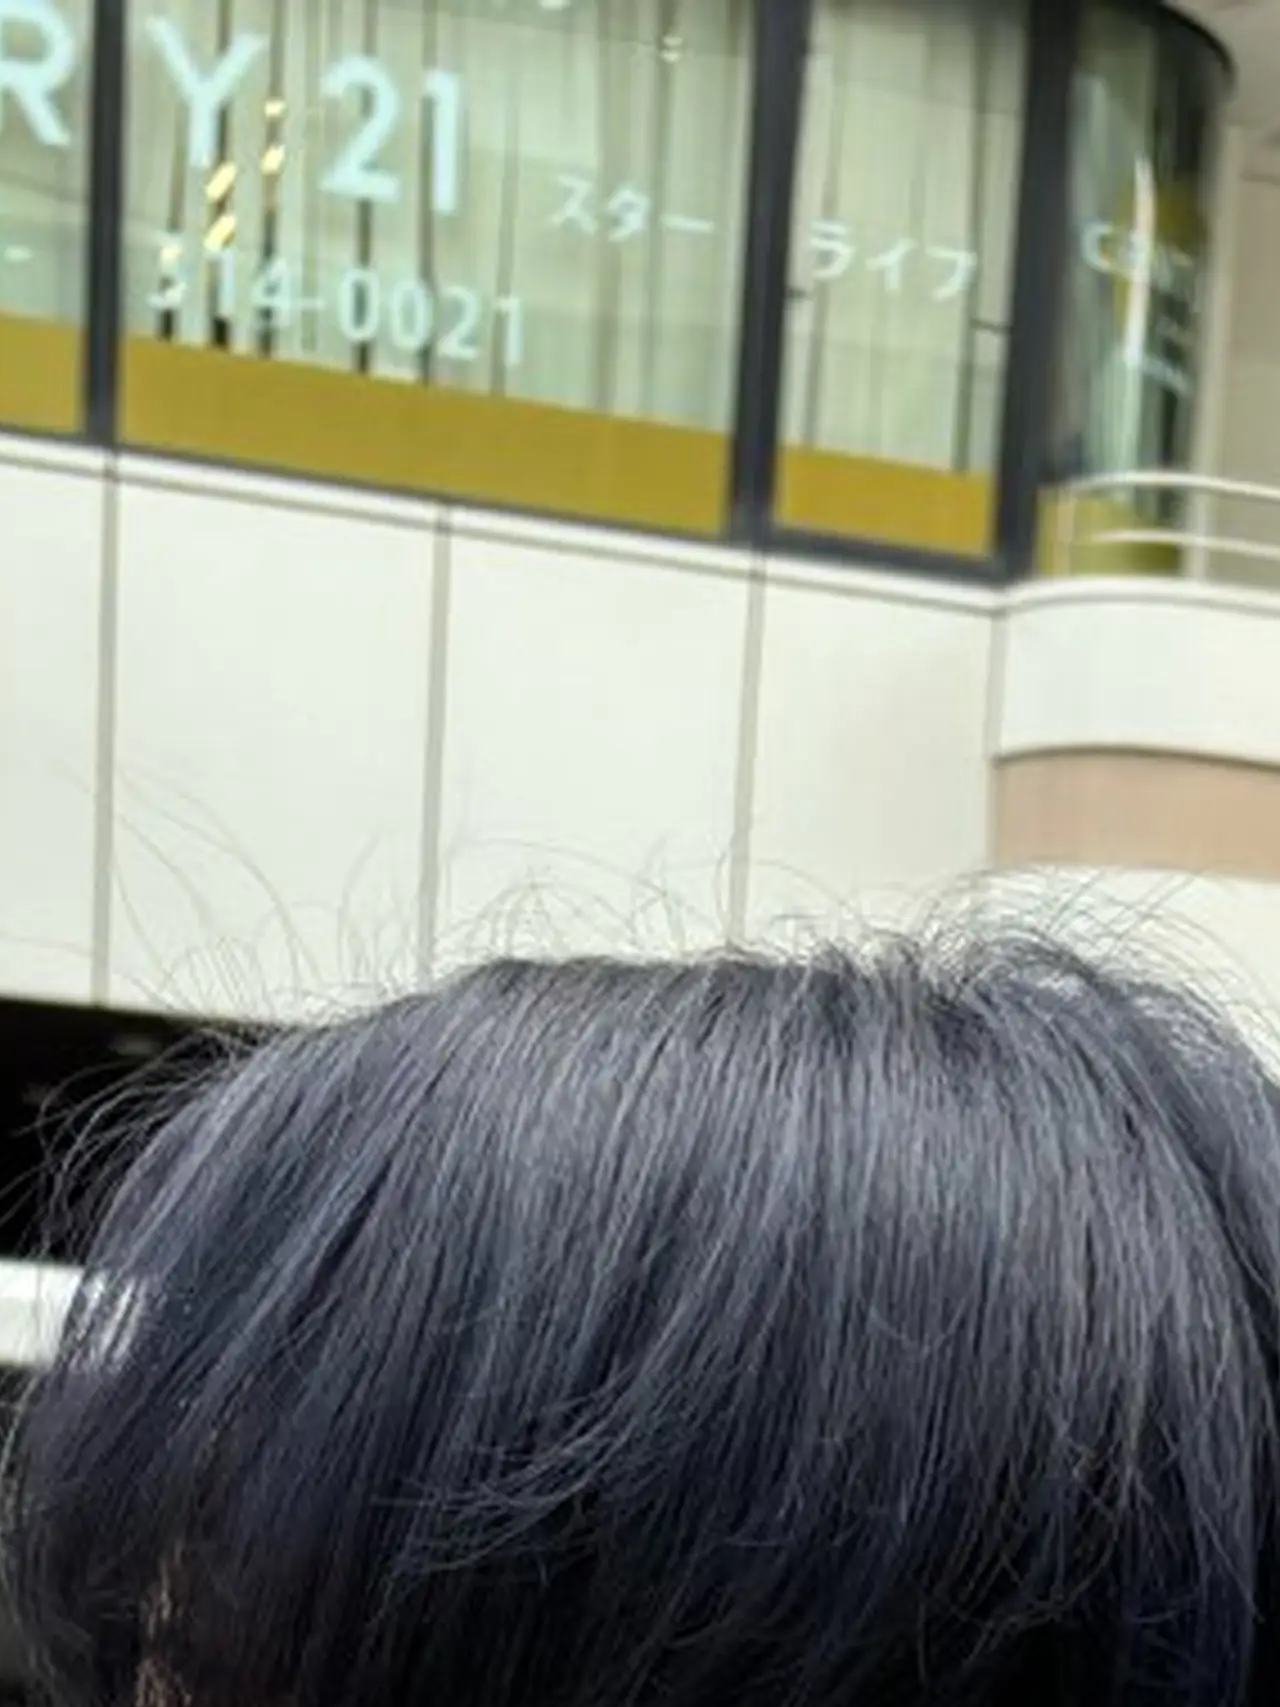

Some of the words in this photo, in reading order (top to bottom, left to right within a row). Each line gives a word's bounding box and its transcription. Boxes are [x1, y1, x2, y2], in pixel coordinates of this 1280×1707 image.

[318, 56, 461, 212] 21
[811, 220, 976, 300] ライフ
